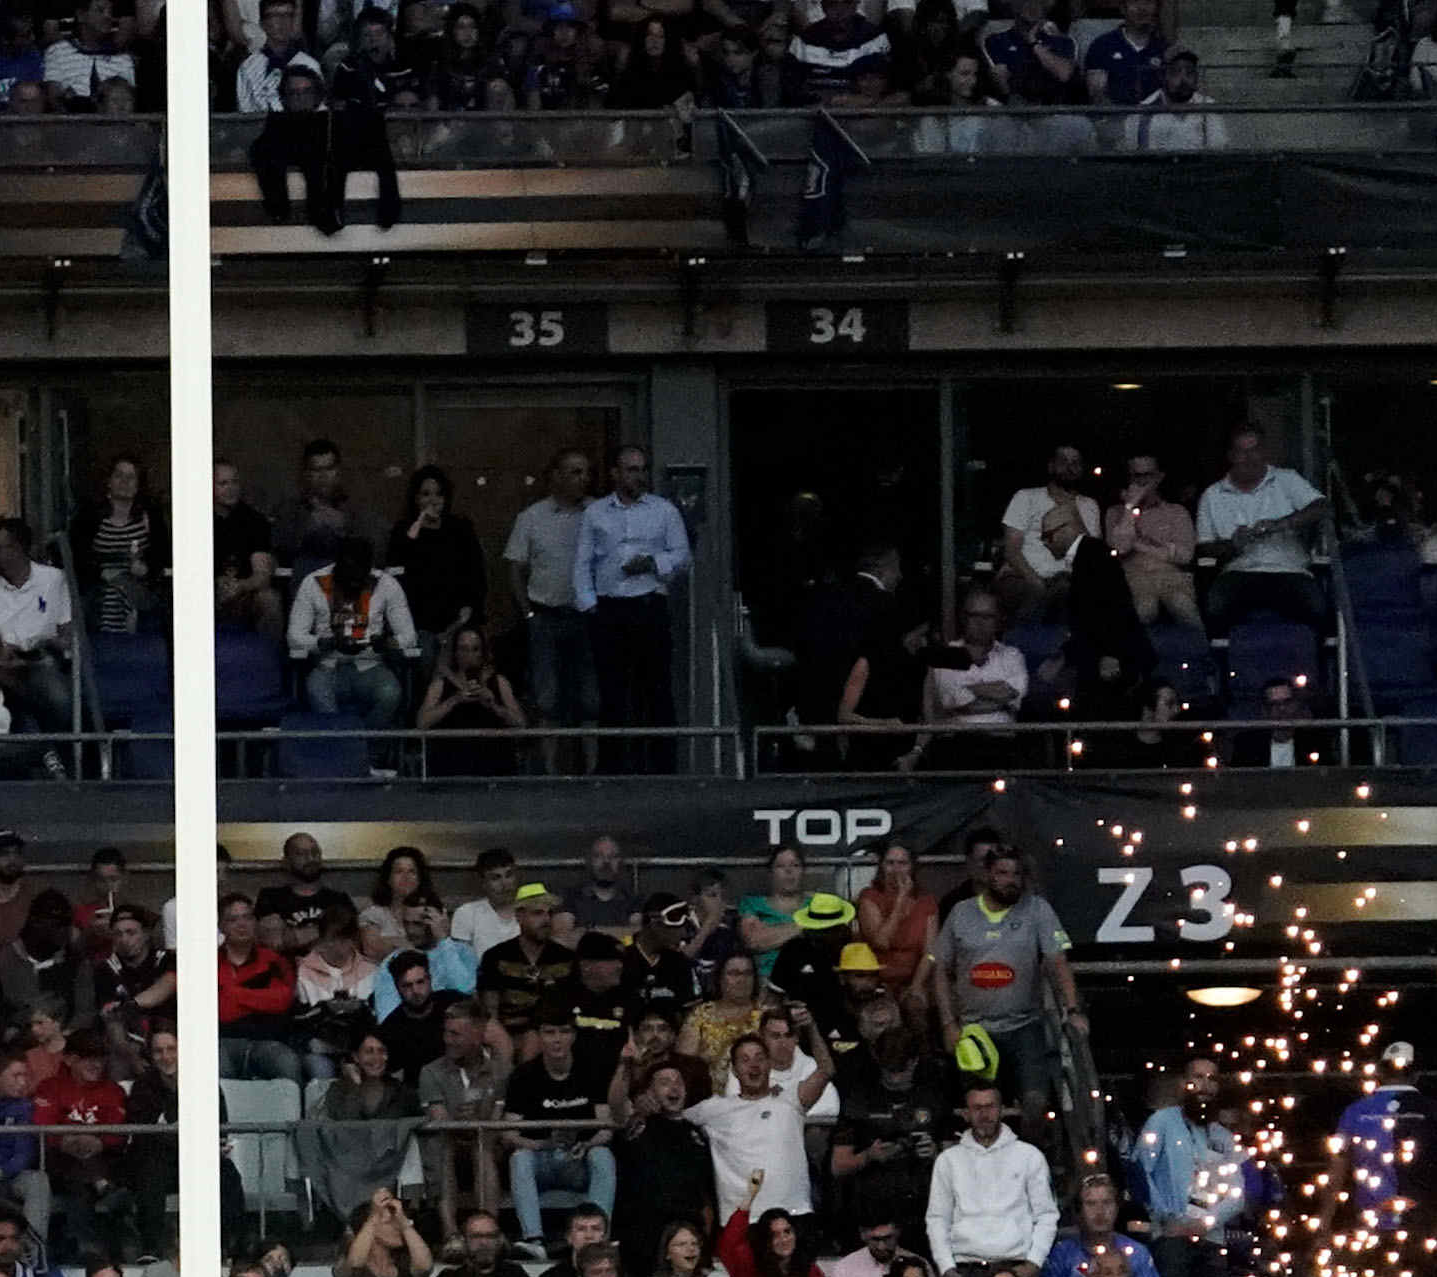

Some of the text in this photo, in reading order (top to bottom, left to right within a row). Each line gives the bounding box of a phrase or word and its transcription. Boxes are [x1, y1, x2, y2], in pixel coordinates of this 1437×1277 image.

[508, 310, 566, 348] 35
[809, 307, 868, 346] 34
[753, 808, 893, 846] TOP
